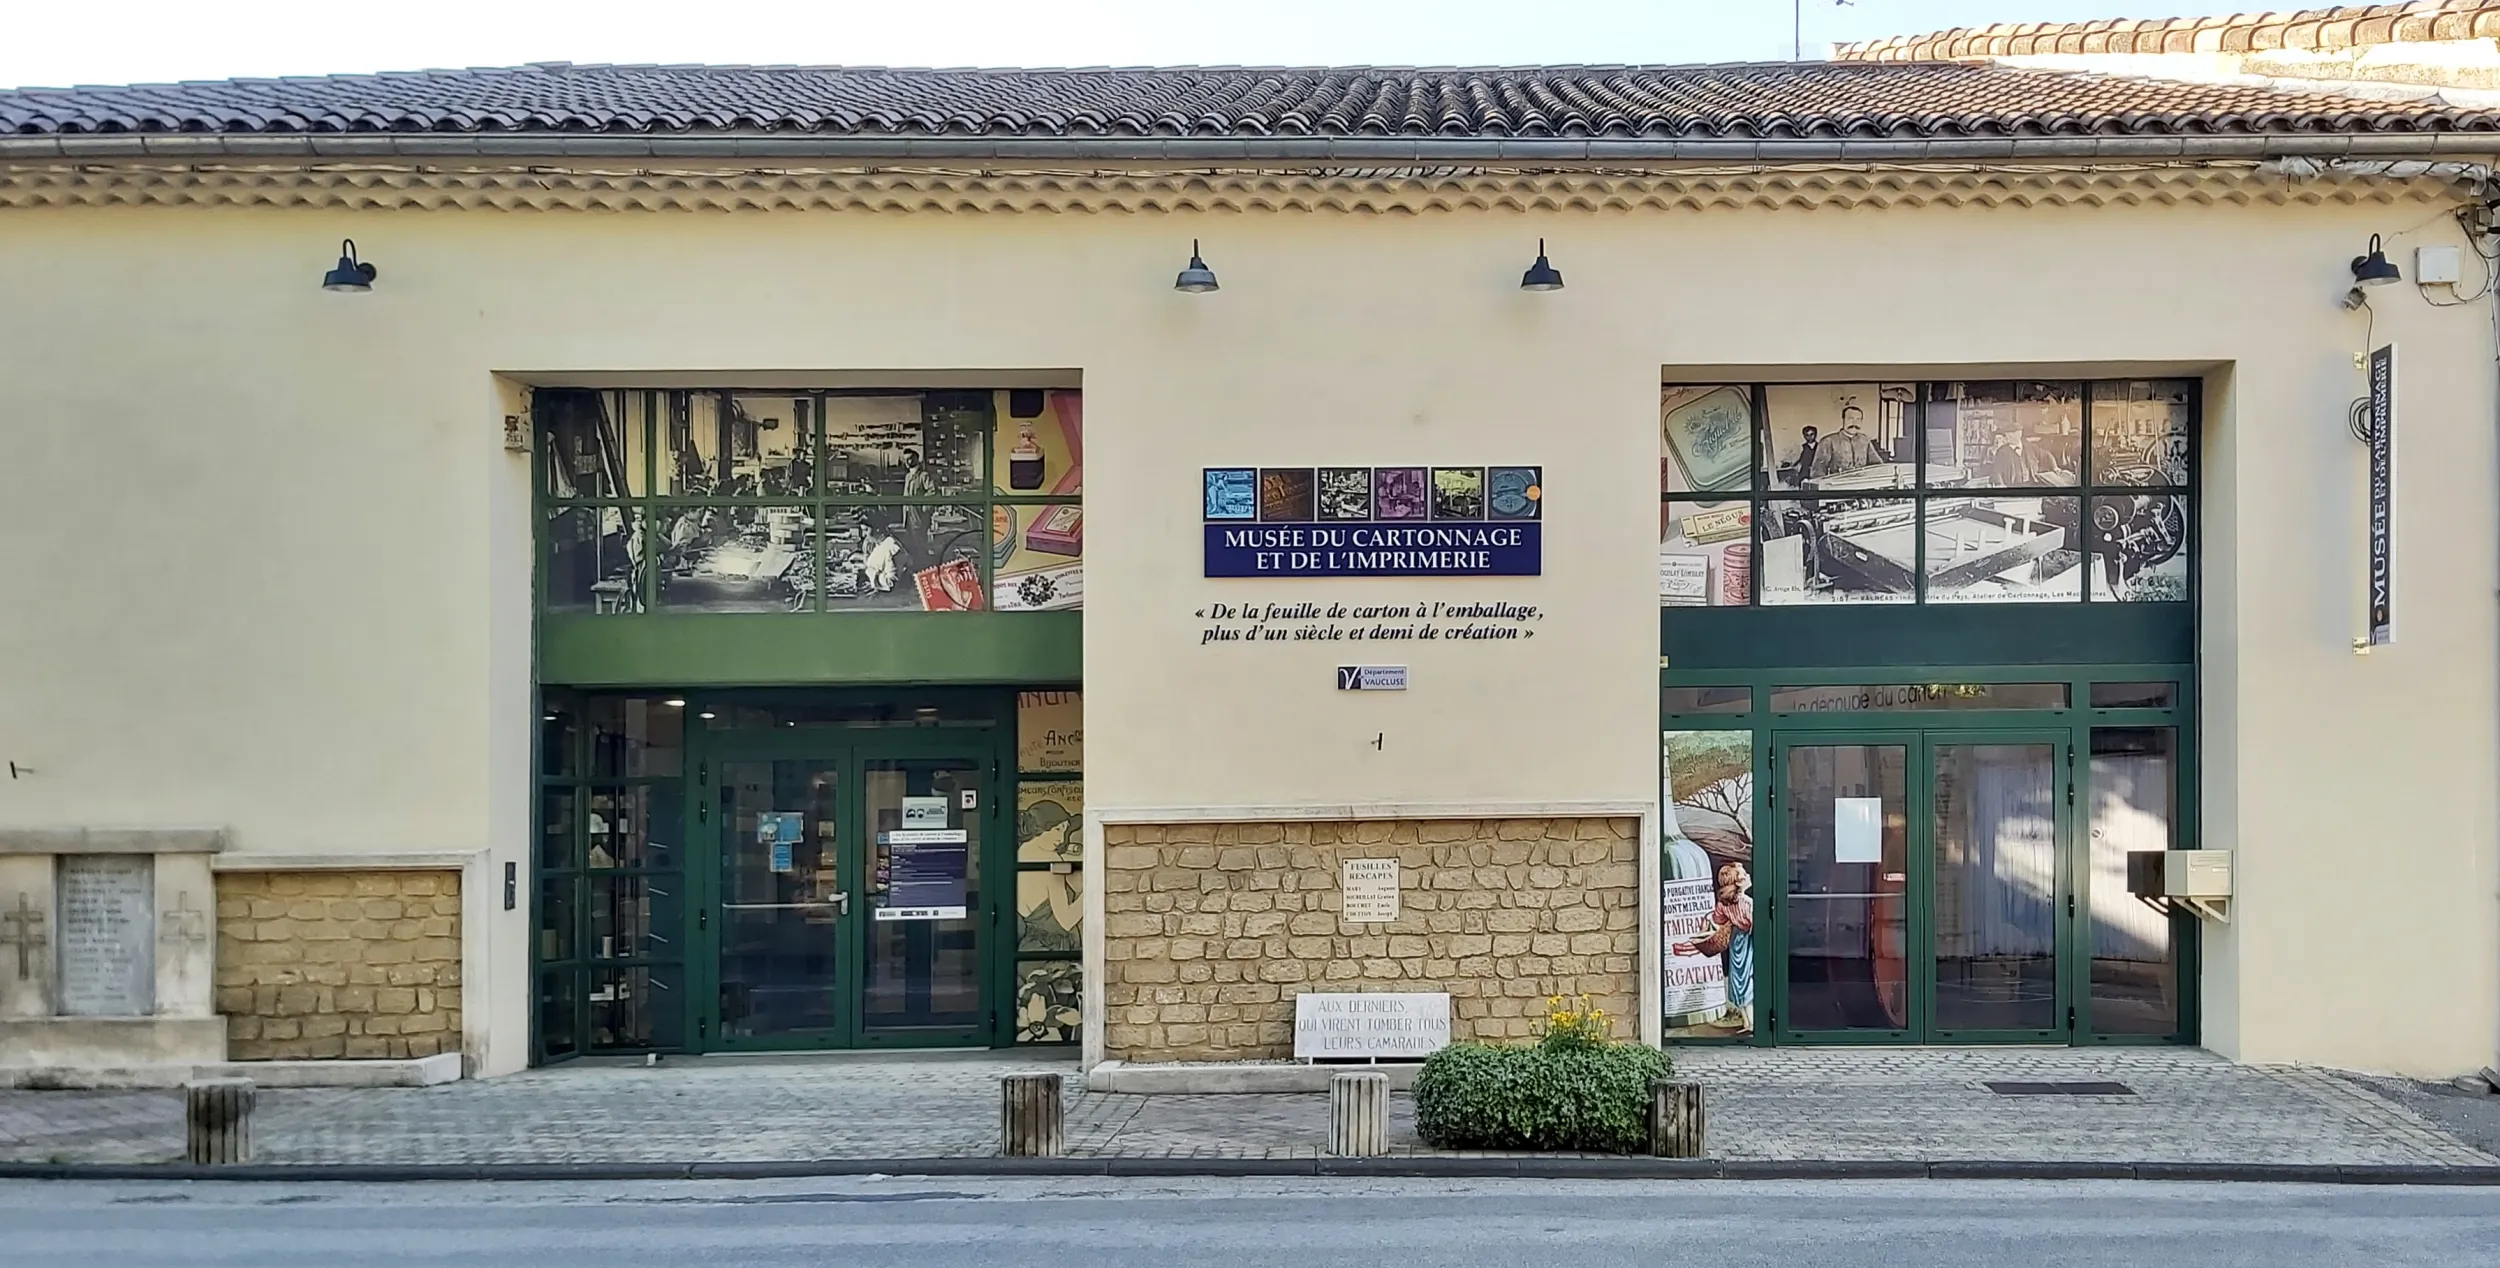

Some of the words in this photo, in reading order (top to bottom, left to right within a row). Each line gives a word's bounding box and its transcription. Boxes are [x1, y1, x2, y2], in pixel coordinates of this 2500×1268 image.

[2374, 476, 2381, 500] DU
[1224, 525, 1305, 548] MUSÉE
[1311, 529, 1347, 548] DU
[1352, 528, 1522, 547] CARTONNAGE
[1257, 552, 1284, 570] ET
[1291, 552, 1322, 570] DE
[2372, 501, 2386, 609] MUSÉE
[1210, 603, 1237, 619] De
[1242, 602, 1259, 619] la
[1260, 602, 1322, 623] feuille
[1326, 602, 1348, 619] de
[1352, 603, 1411, 619] carton
[1415, 601, 1428, 618] à
[1200, 624, 1241, 645] plus
[1293, 624, 1344, 641] siècle
[1349, 626, 1366, 640] et
[1369, 623, 1415, 640] demi
[1418, 623, 1440, 640] de
[1444, 622, 1519, 640] création
[1364, 678, 1404, 686] VAUCLUSE
[1875, 686, 1894, 707] du
[1318, 1000, 1342, 1013] AUX
[1348, 1000, 1408, 1014] DERNIERS,
[1321, 1018, 1361, 1032] VIRENT
[1367, 1017, 1412, 1032] TOMBER
[1418, 1017, 1447, 1031] TOUS
[1323, 1036, 1362, 1050] LEURS
[1367, 1036, 1437, 1050] CAMARADES
